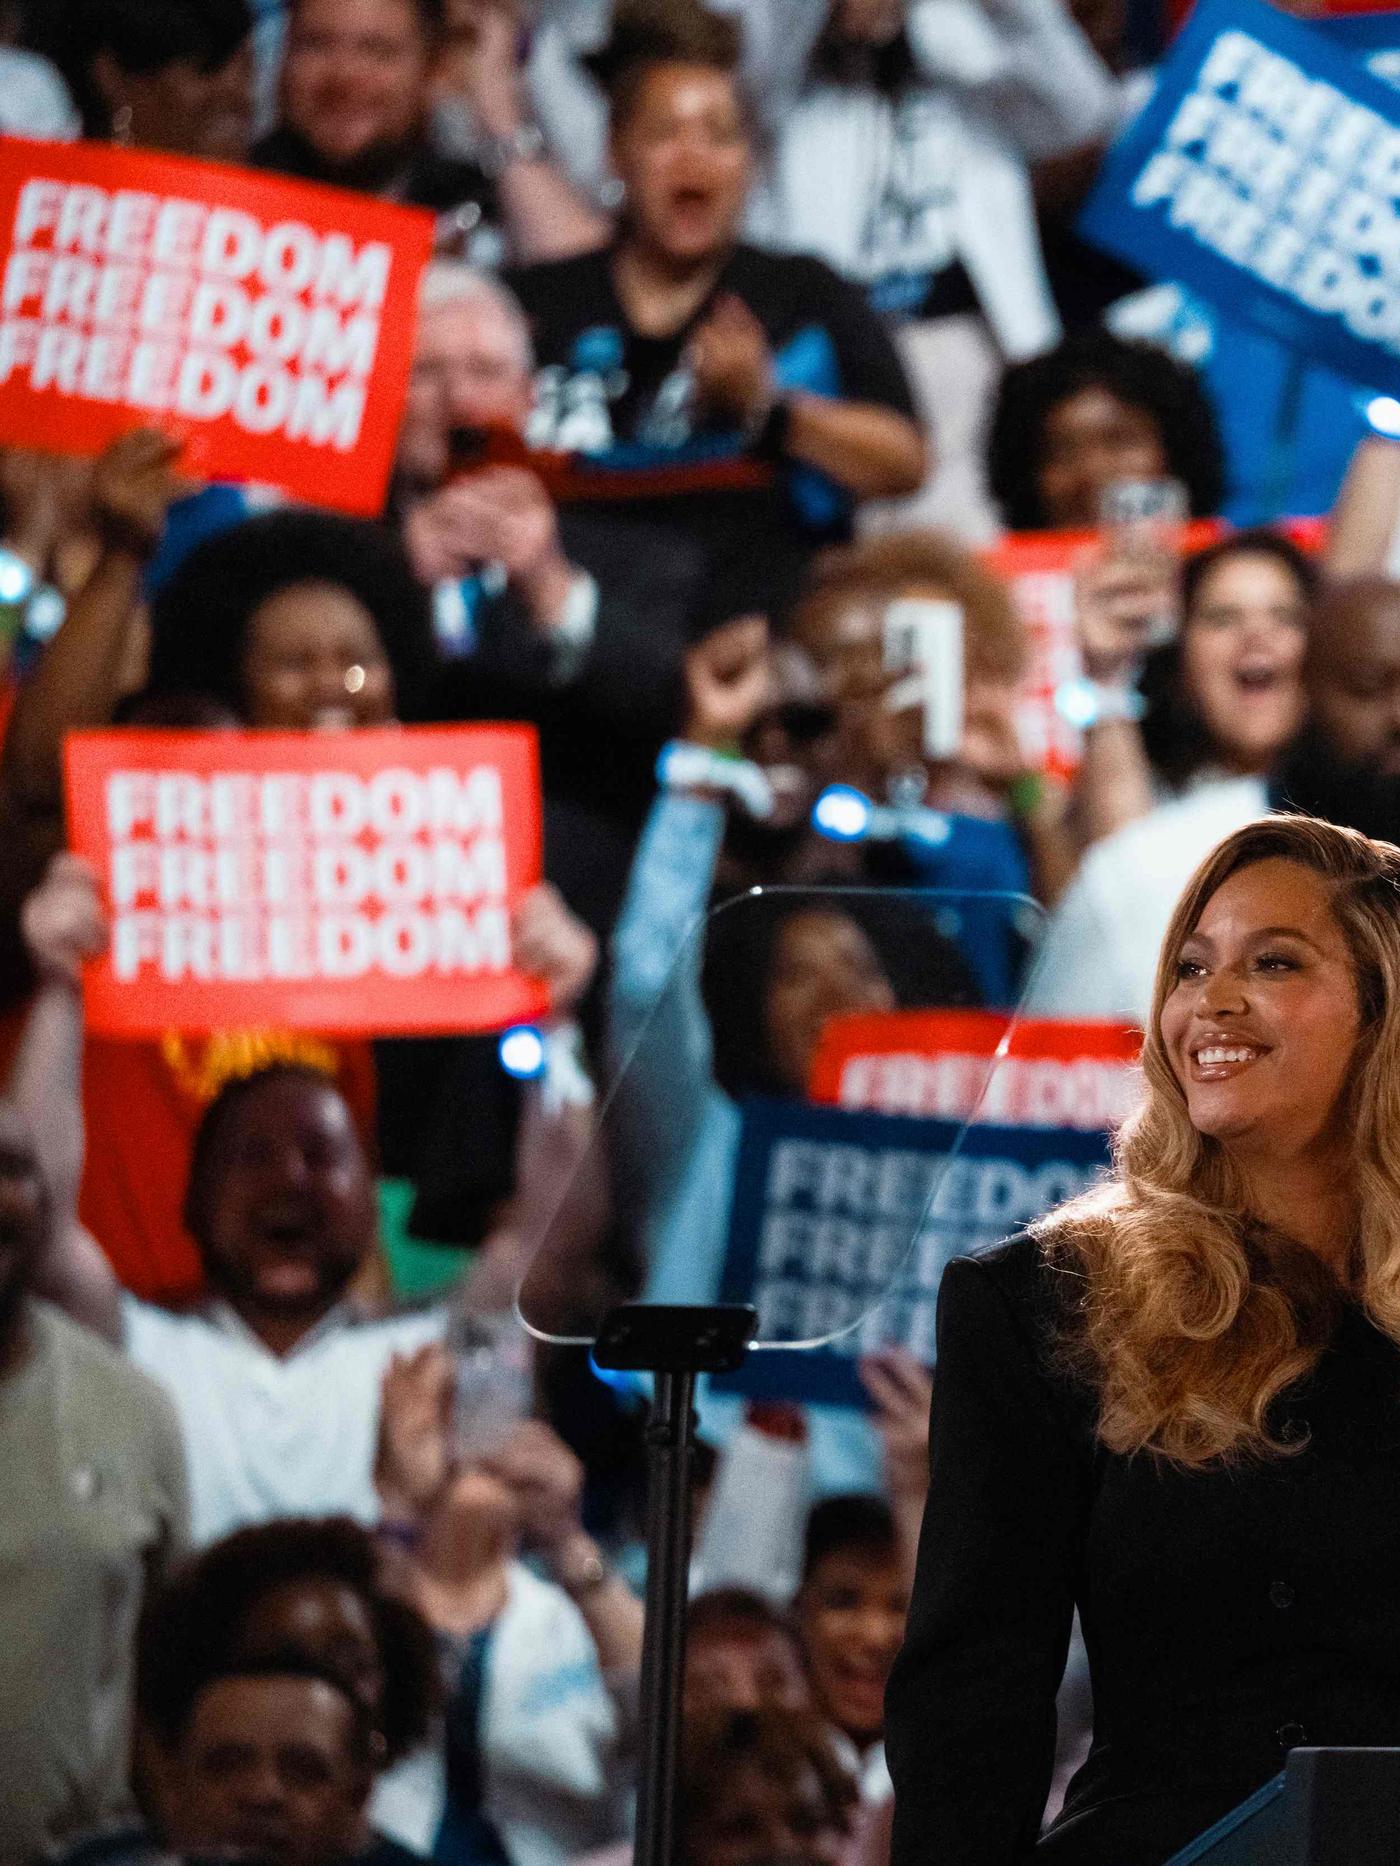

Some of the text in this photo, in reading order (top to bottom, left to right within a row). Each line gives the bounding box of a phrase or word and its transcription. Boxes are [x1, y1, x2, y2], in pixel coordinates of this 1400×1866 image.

[14, 178, 394, 307] FREEDOM
[3, 250, 380, 377] FREEDOM
[0, 322, 368, 453] FREEDOM
[107, 765, 502, 836] FREEDOM
[111, 834, 507, 906] FREEDOM
[113, 904, 511, 984] FREEDOM
